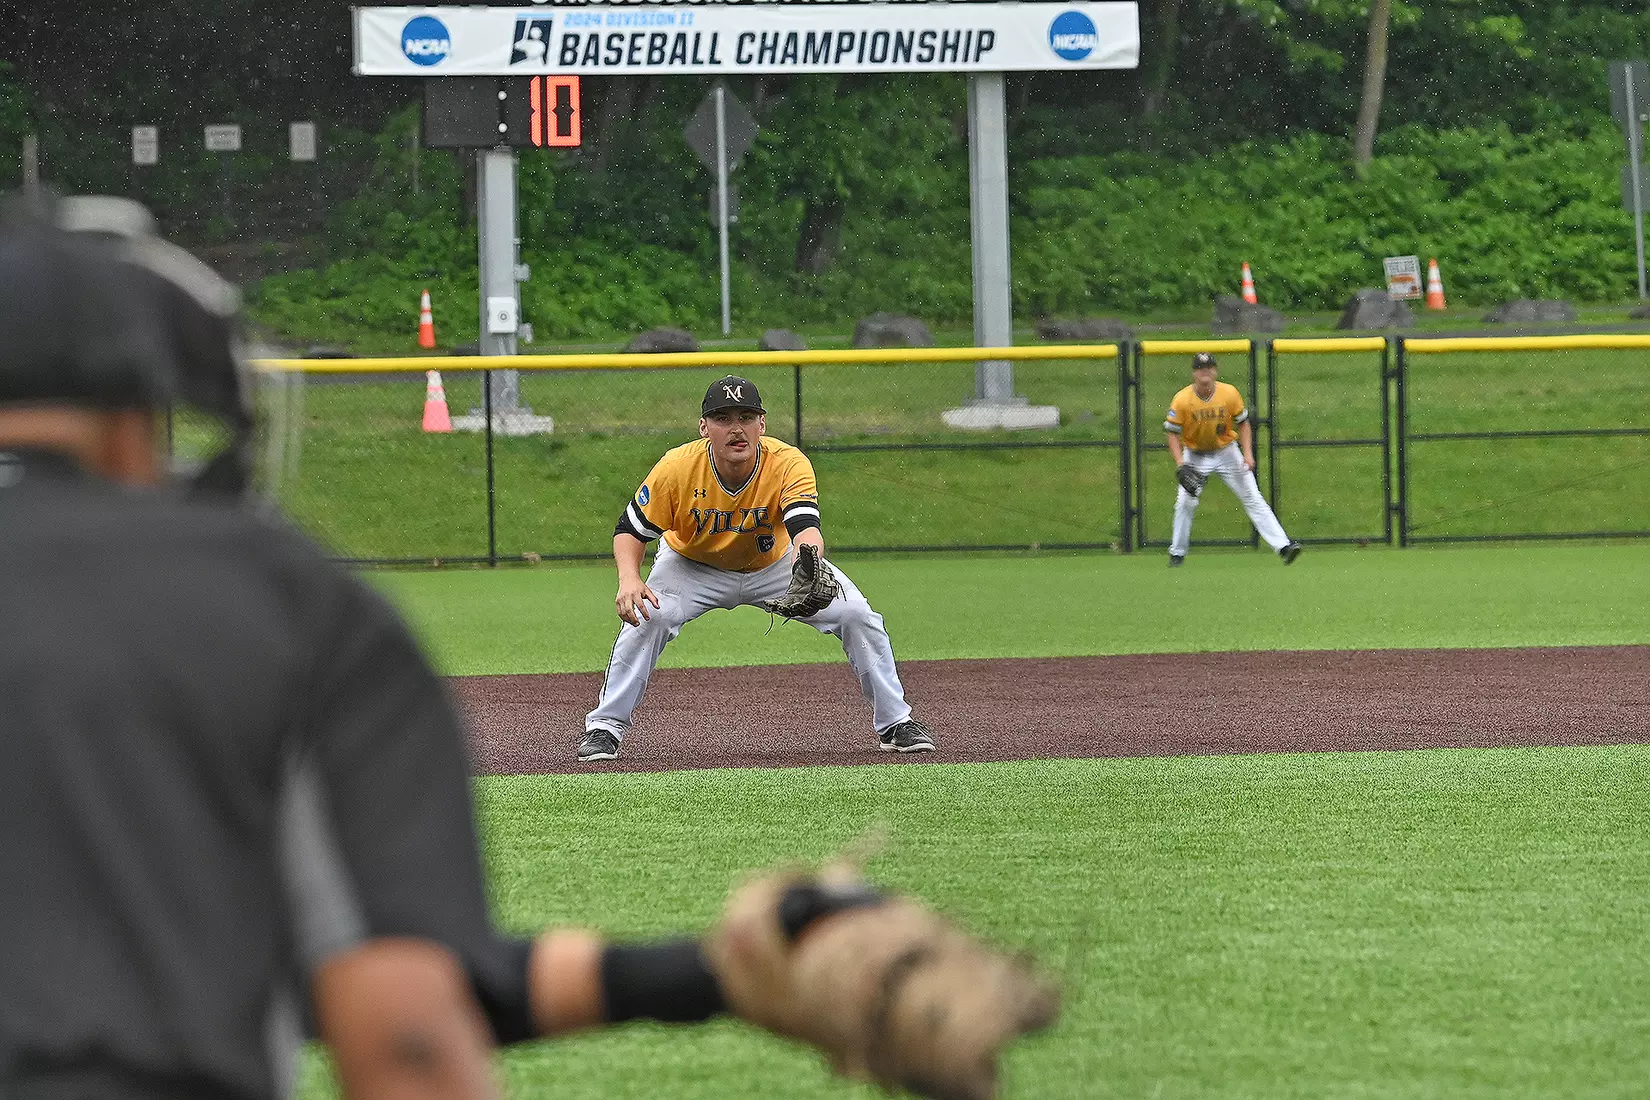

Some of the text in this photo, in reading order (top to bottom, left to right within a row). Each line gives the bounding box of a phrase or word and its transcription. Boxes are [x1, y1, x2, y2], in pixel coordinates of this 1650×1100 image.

[564, 12, 694, 27] 2024 DIVISION II
[559, 30, 996, 66] BASEBALL CHAMPIONSHIP
[530, 76, 581, 147] 10
[722, 385, 744, 403] M
[689, 506, 774, 537] VILLE
